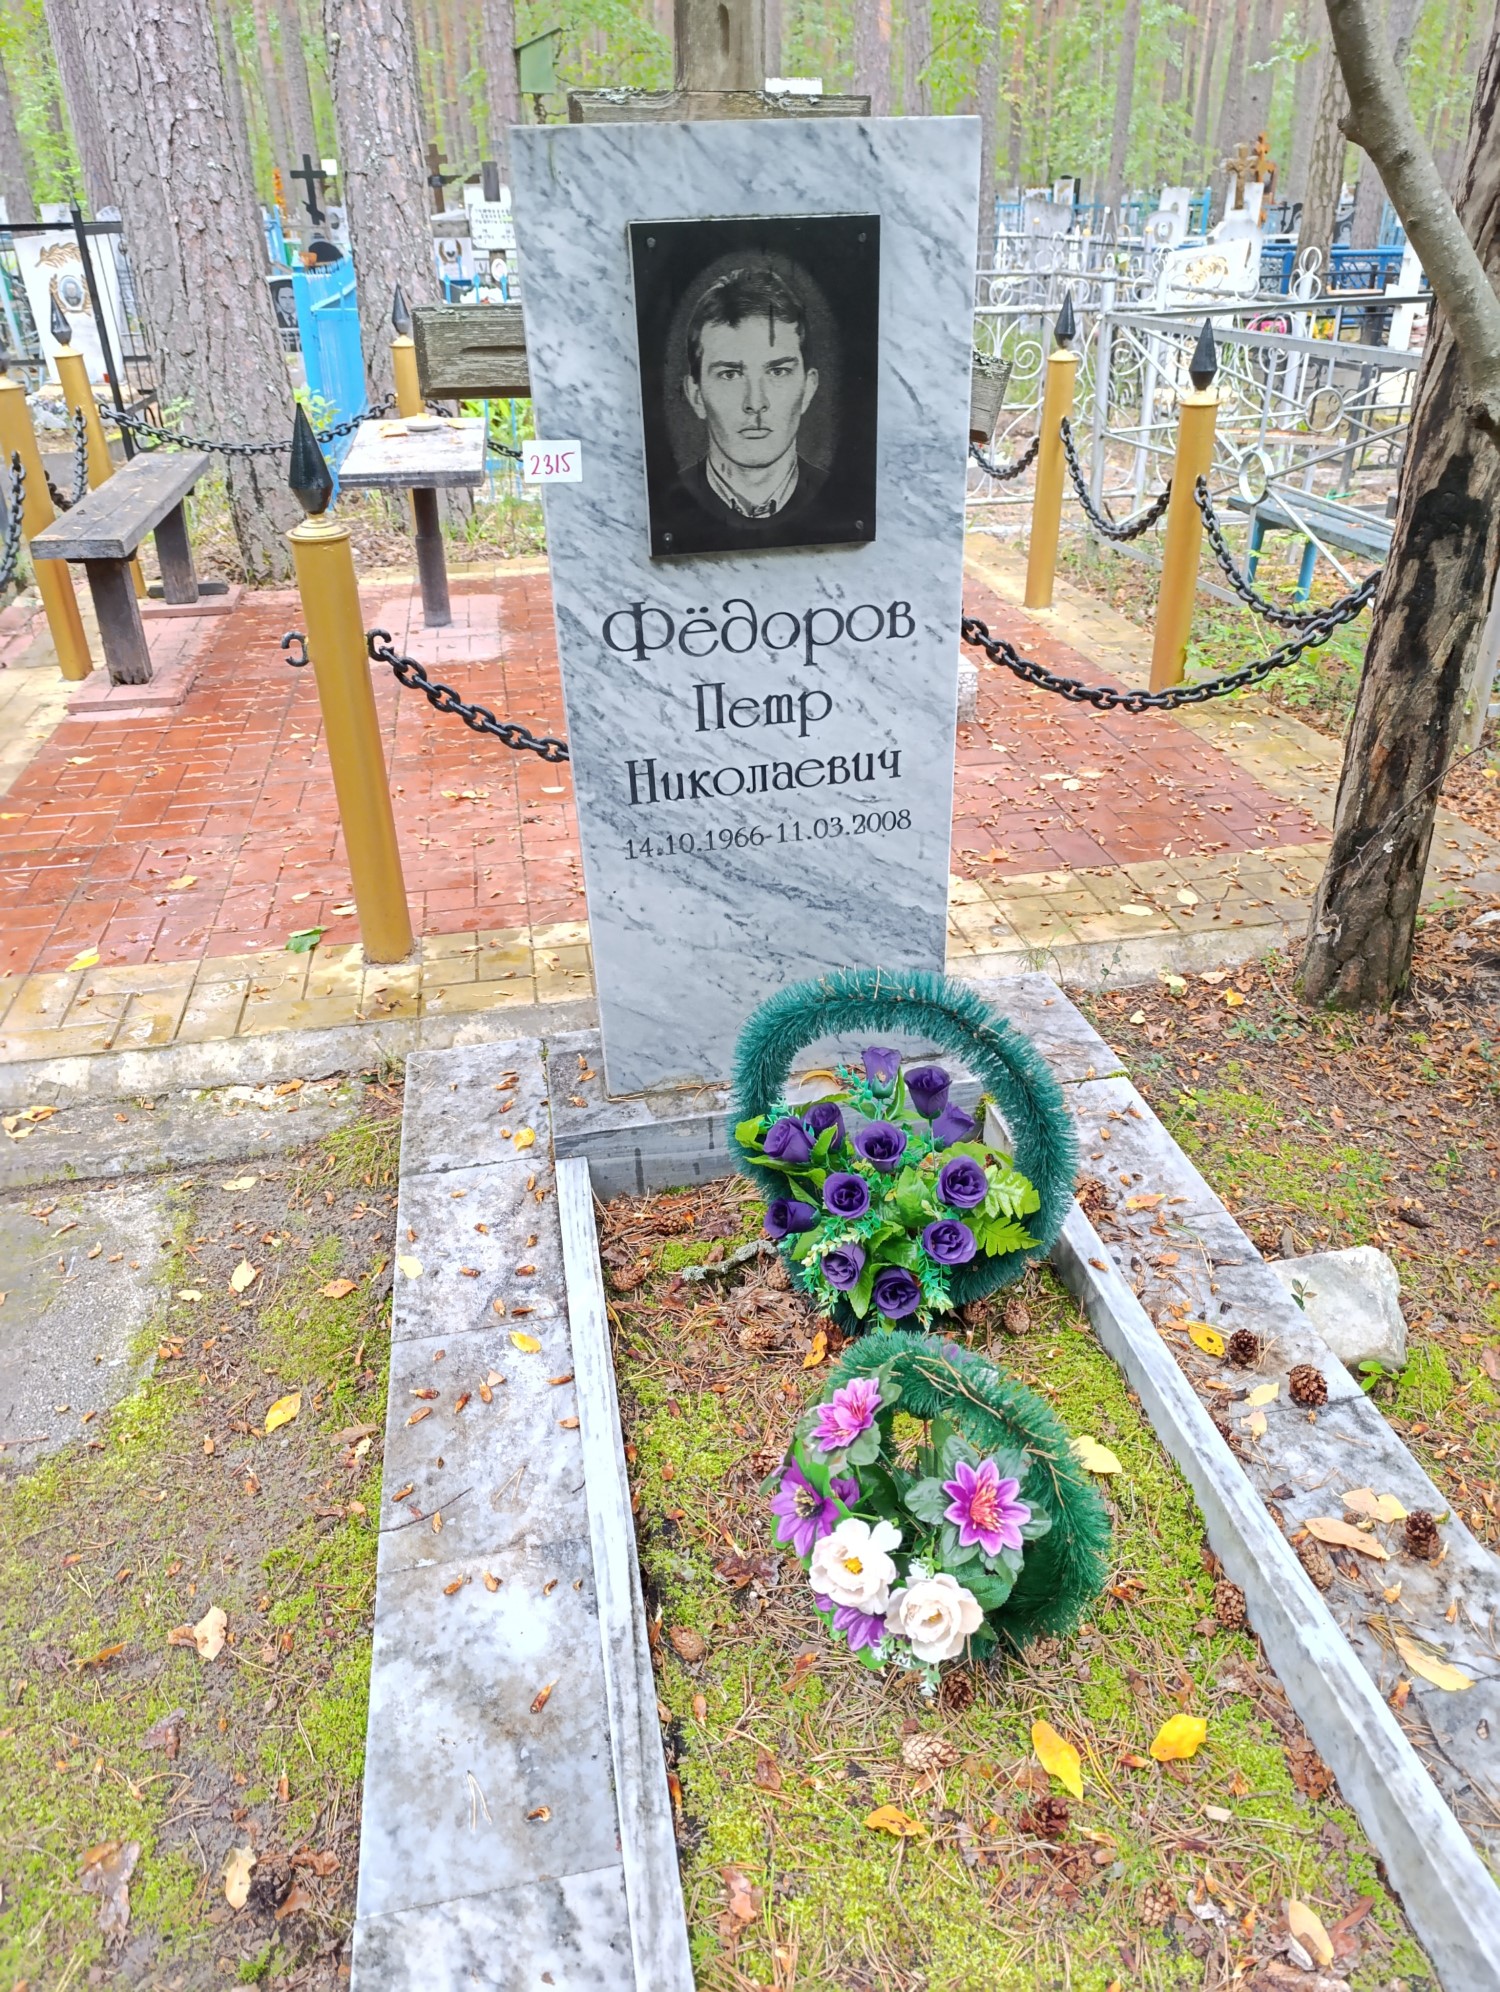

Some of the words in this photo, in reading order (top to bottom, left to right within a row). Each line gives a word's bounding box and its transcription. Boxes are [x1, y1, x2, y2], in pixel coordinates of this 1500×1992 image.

[530, 451, 576, 475] 2315
[602, 598, 916, 667] Фёдоров
[692, 682, 832, 738] Петр
[625, 749, 902, 806] Николаевич
